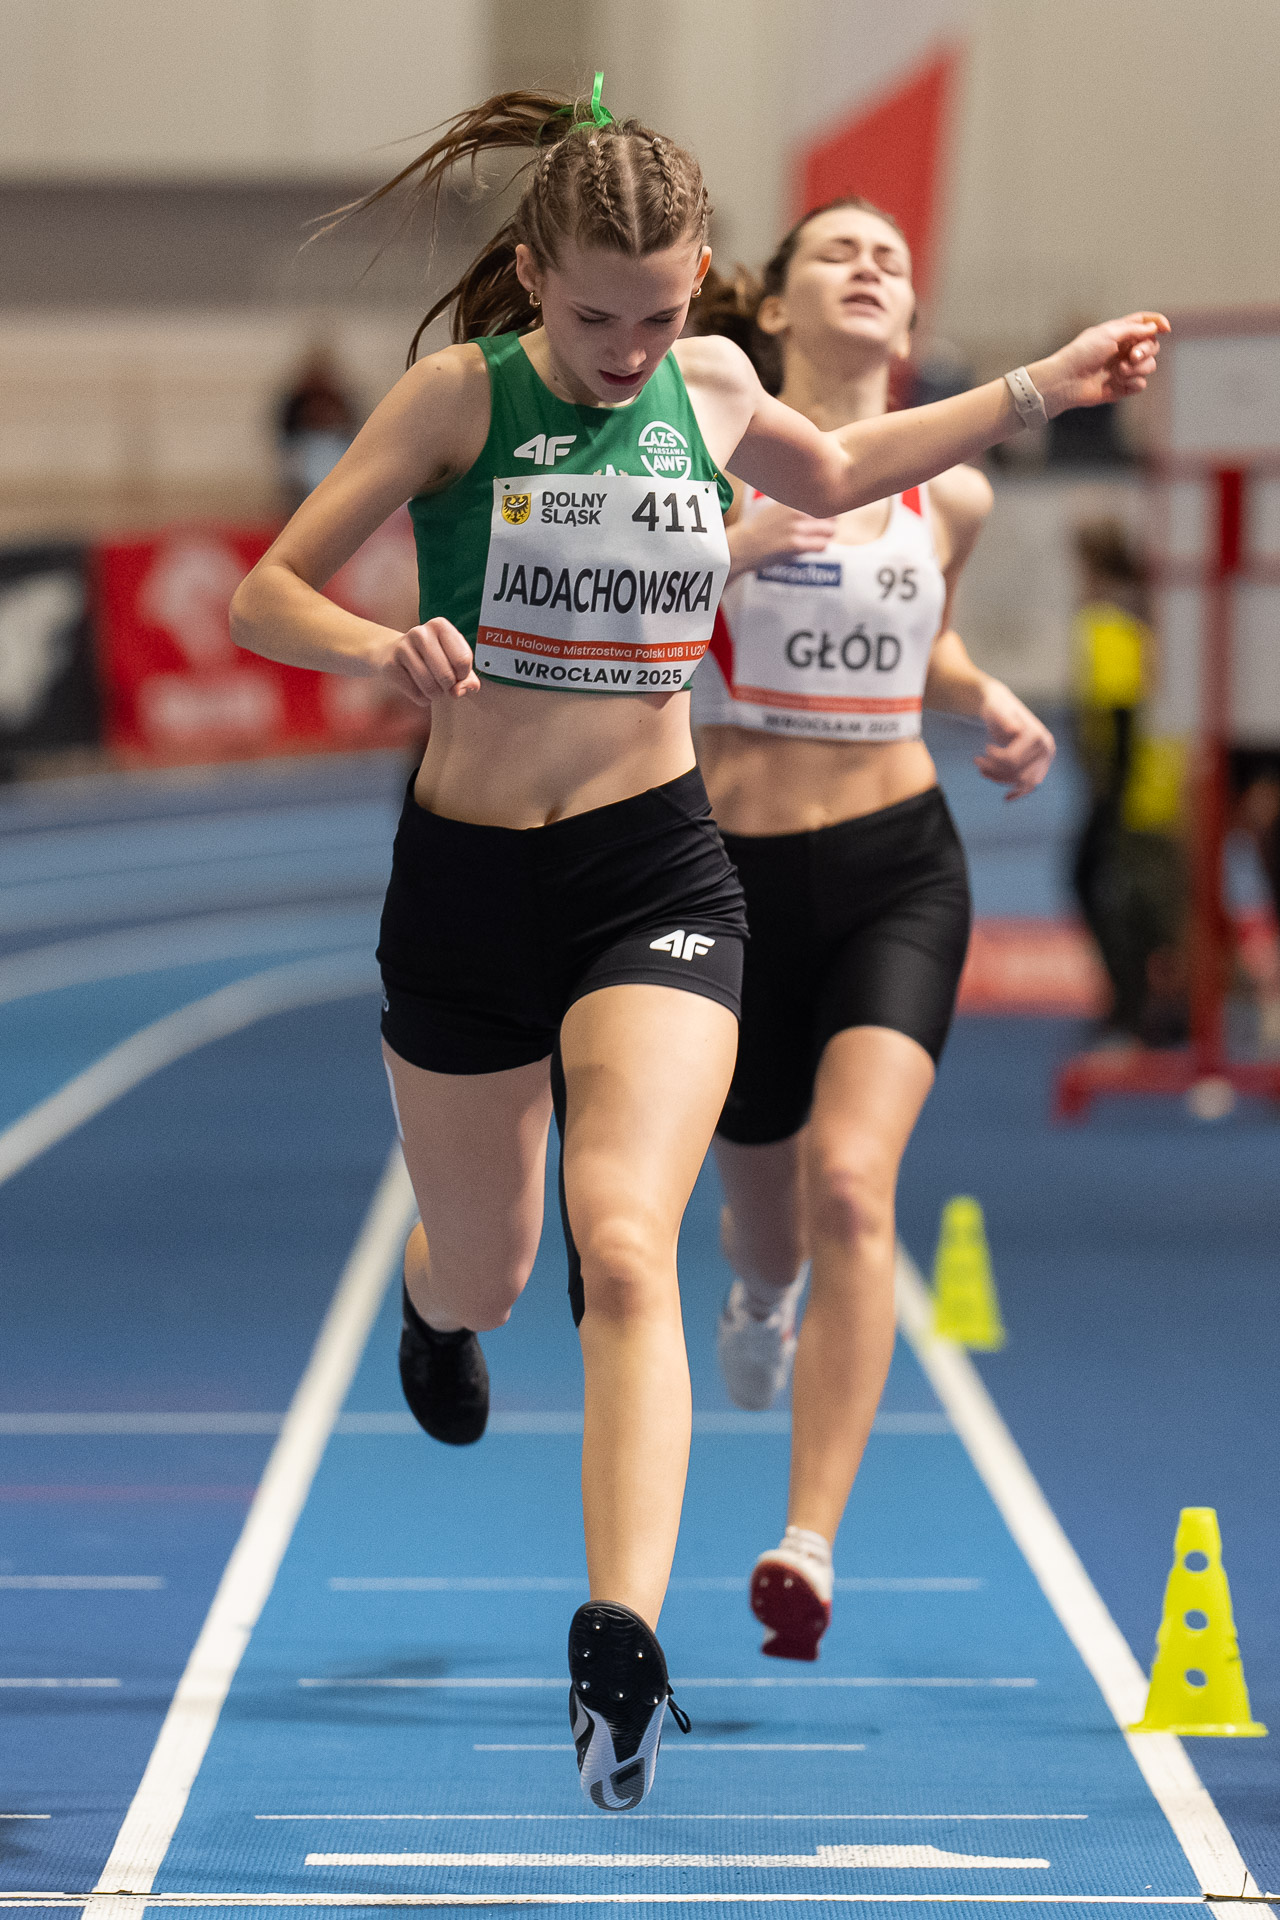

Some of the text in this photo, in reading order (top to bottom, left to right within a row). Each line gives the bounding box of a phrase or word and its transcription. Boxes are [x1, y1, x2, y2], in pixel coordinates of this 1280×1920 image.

[514, 434, 577, 465] 4F
[646, 447, 686, 455] WARSZAWA
[650, 431, 678, 448] AZS
[653, 455, 686, 471] AWF
[541, 491, 607, 508] DOLNY
[631, 491, 708, 534] 411
[540, 506, 602, 527] ŚLĄSK
[493, 563, 714, 614] JADACHOWSKA
[877, 567, 918, 602] 95
[486, 631, 706, 659] PZLA Halowe Mistrzostwa Polski U18 i U20
[785, 621, 901, 672] GŁÓD
[514, 658, 682, 685] WROCŁAW 2025
[649, 929, 716, 961] 4F
